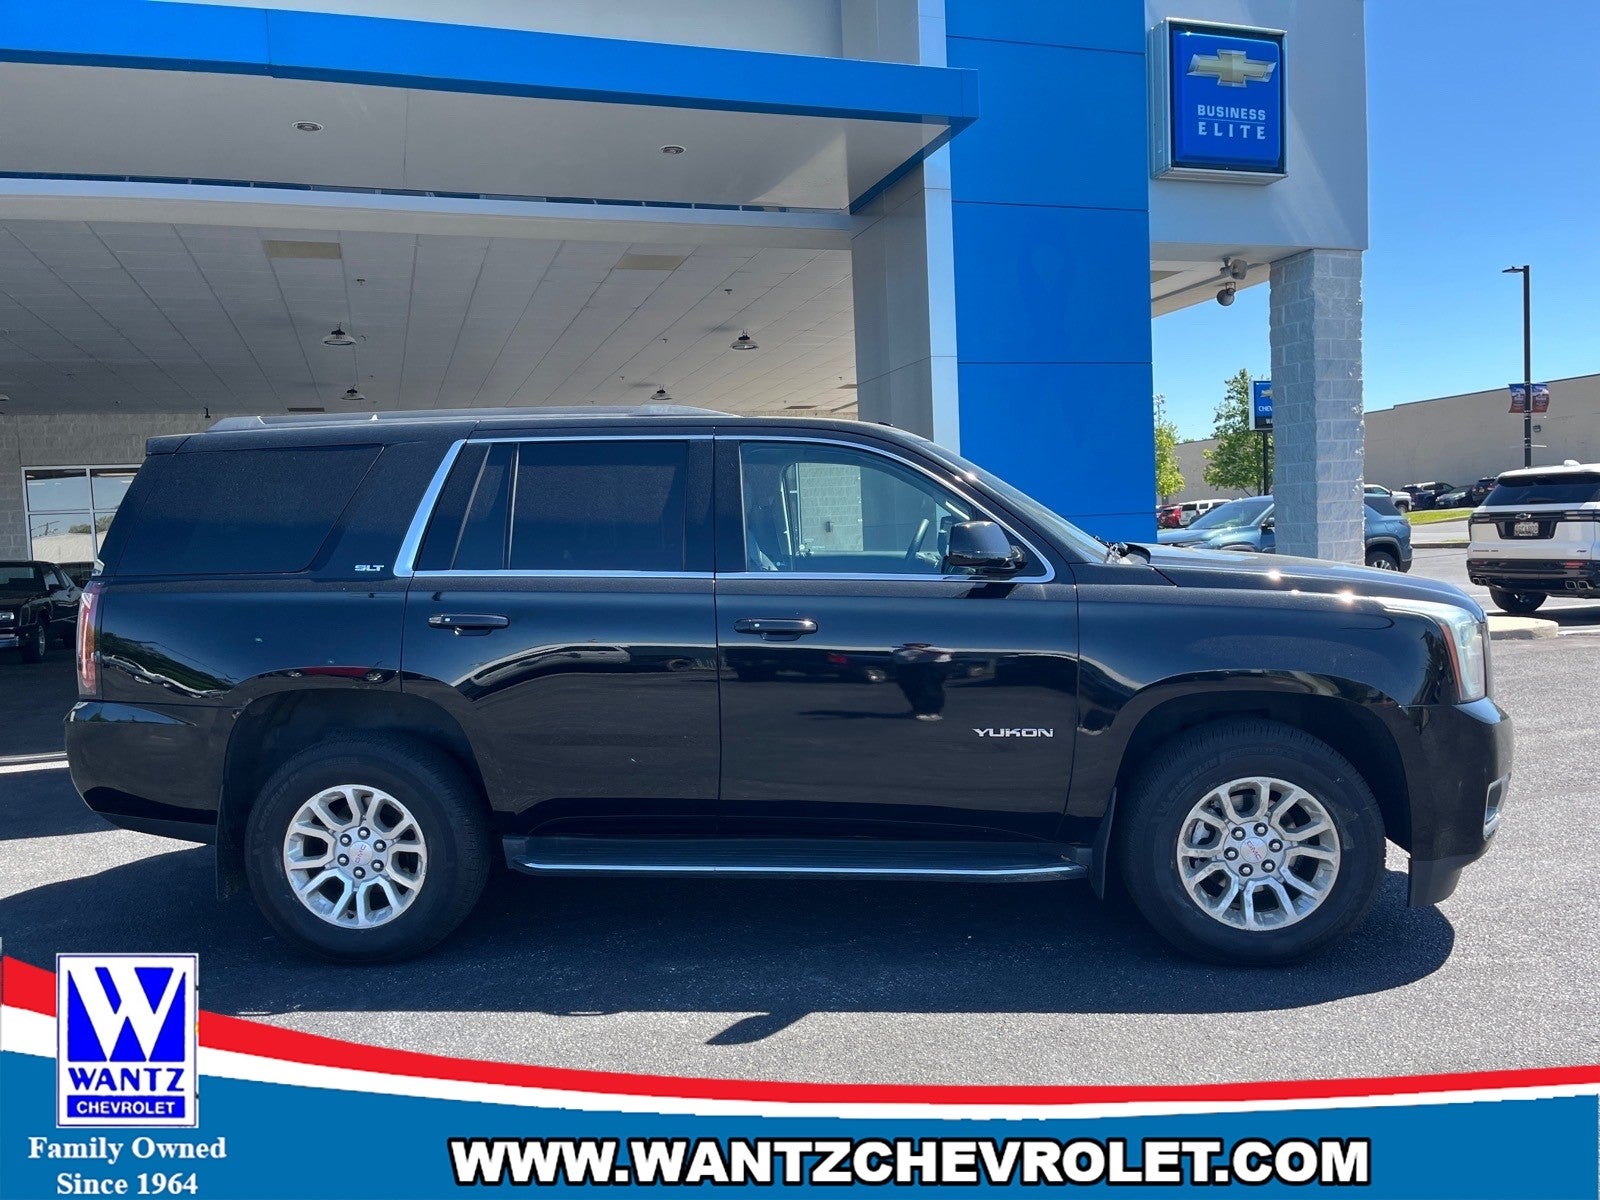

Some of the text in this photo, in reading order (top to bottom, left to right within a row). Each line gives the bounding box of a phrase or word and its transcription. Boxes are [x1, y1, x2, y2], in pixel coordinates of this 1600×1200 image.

[1197, 104, 1266, 120] BUSINESS
[1198, 121, 1266, 140] ELITE
[354, 564, 385, 572] SLT
[972, 728, 1054, 738] YUKON
[1246, 840, 1263, 861] GMC
